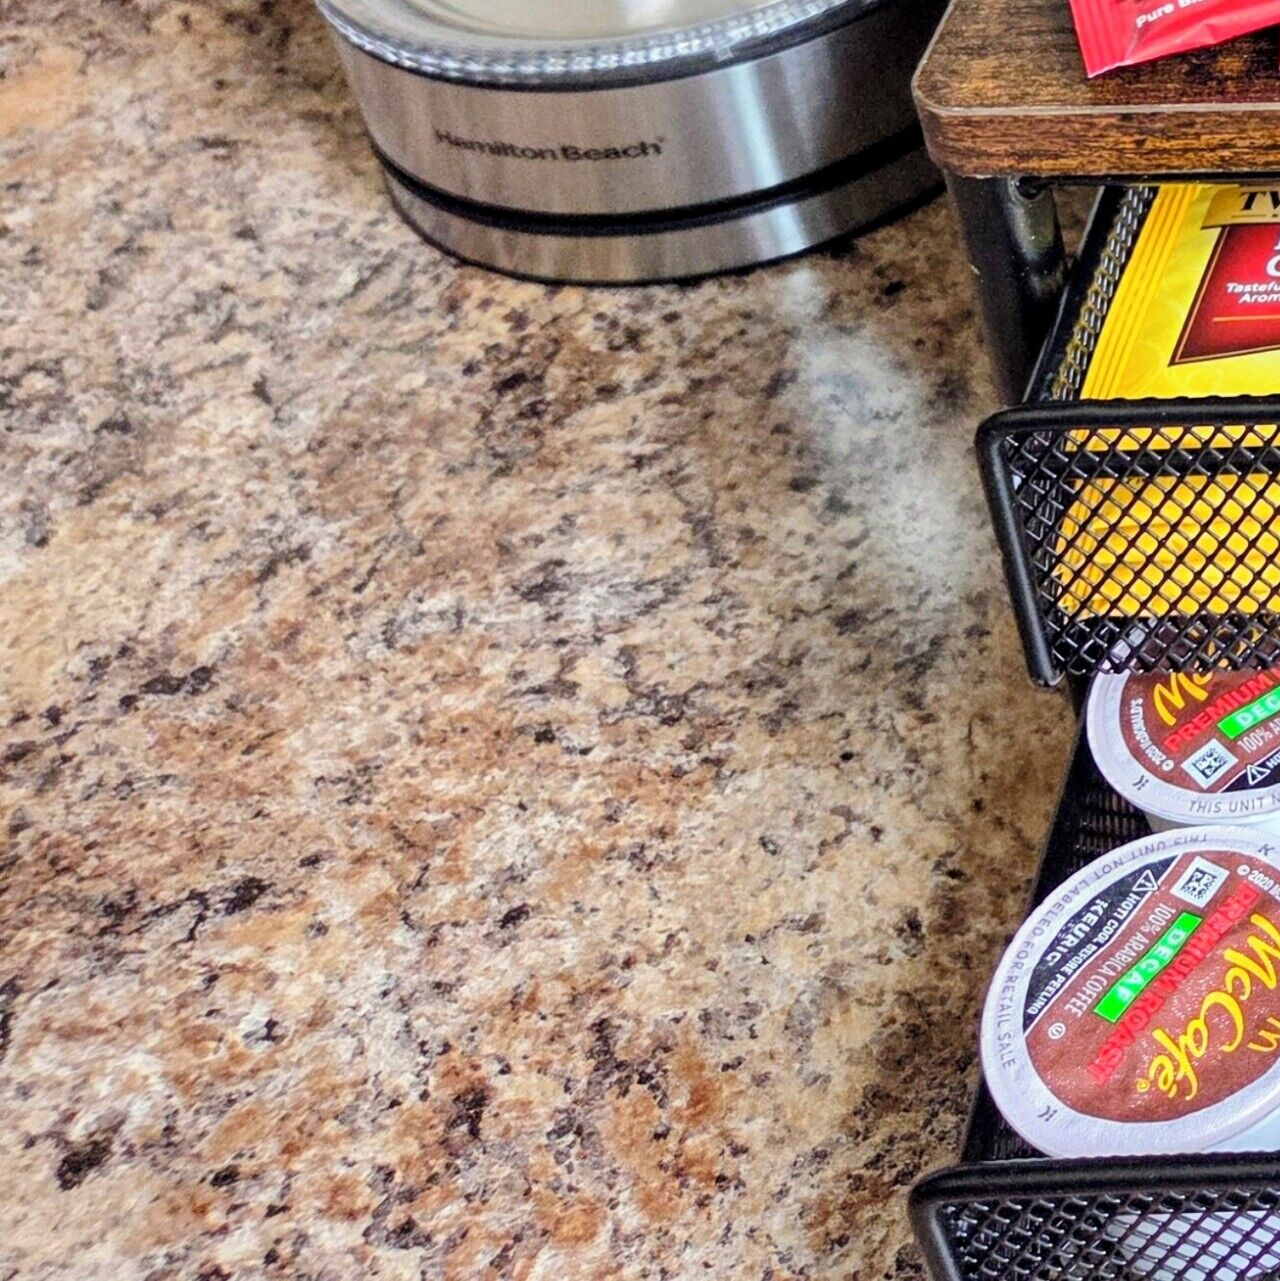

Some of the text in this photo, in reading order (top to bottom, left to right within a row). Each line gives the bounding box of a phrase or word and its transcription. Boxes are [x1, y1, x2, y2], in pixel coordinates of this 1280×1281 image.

[1135, 3, 1175, 29] Pure
[435, 129, 662, 161] Hamilton Beach
[1164, 675, 1274, 753] PREMIUM
[1046, 899, 1108, 966] KEURIG
[1115, 928, 1191, 1004] DECAF
